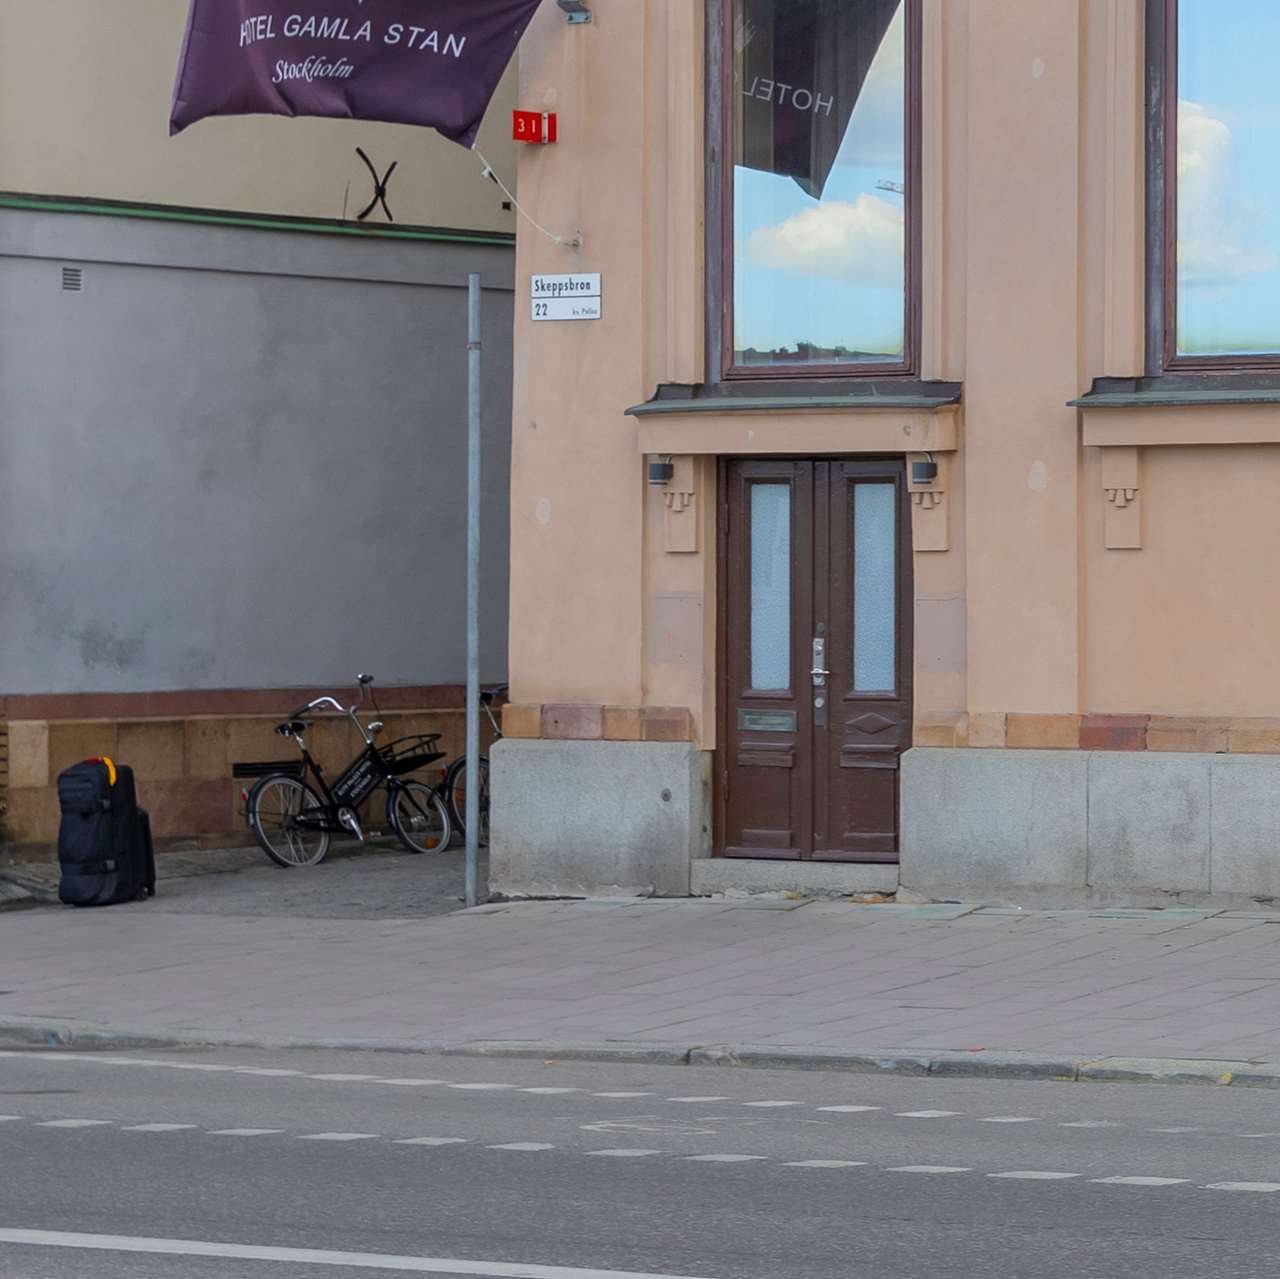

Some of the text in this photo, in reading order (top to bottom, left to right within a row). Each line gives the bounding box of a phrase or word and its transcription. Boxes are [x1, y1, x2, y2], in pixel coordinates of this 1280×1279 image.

[284, 15, 371, 41] GAMLA
[384, 24, 466, 58] STAN
[272, 56, 354, 83] Stockholm
[535, 277, 591, 296] Skeppsbron
[535, 303, 548, 316] 22
